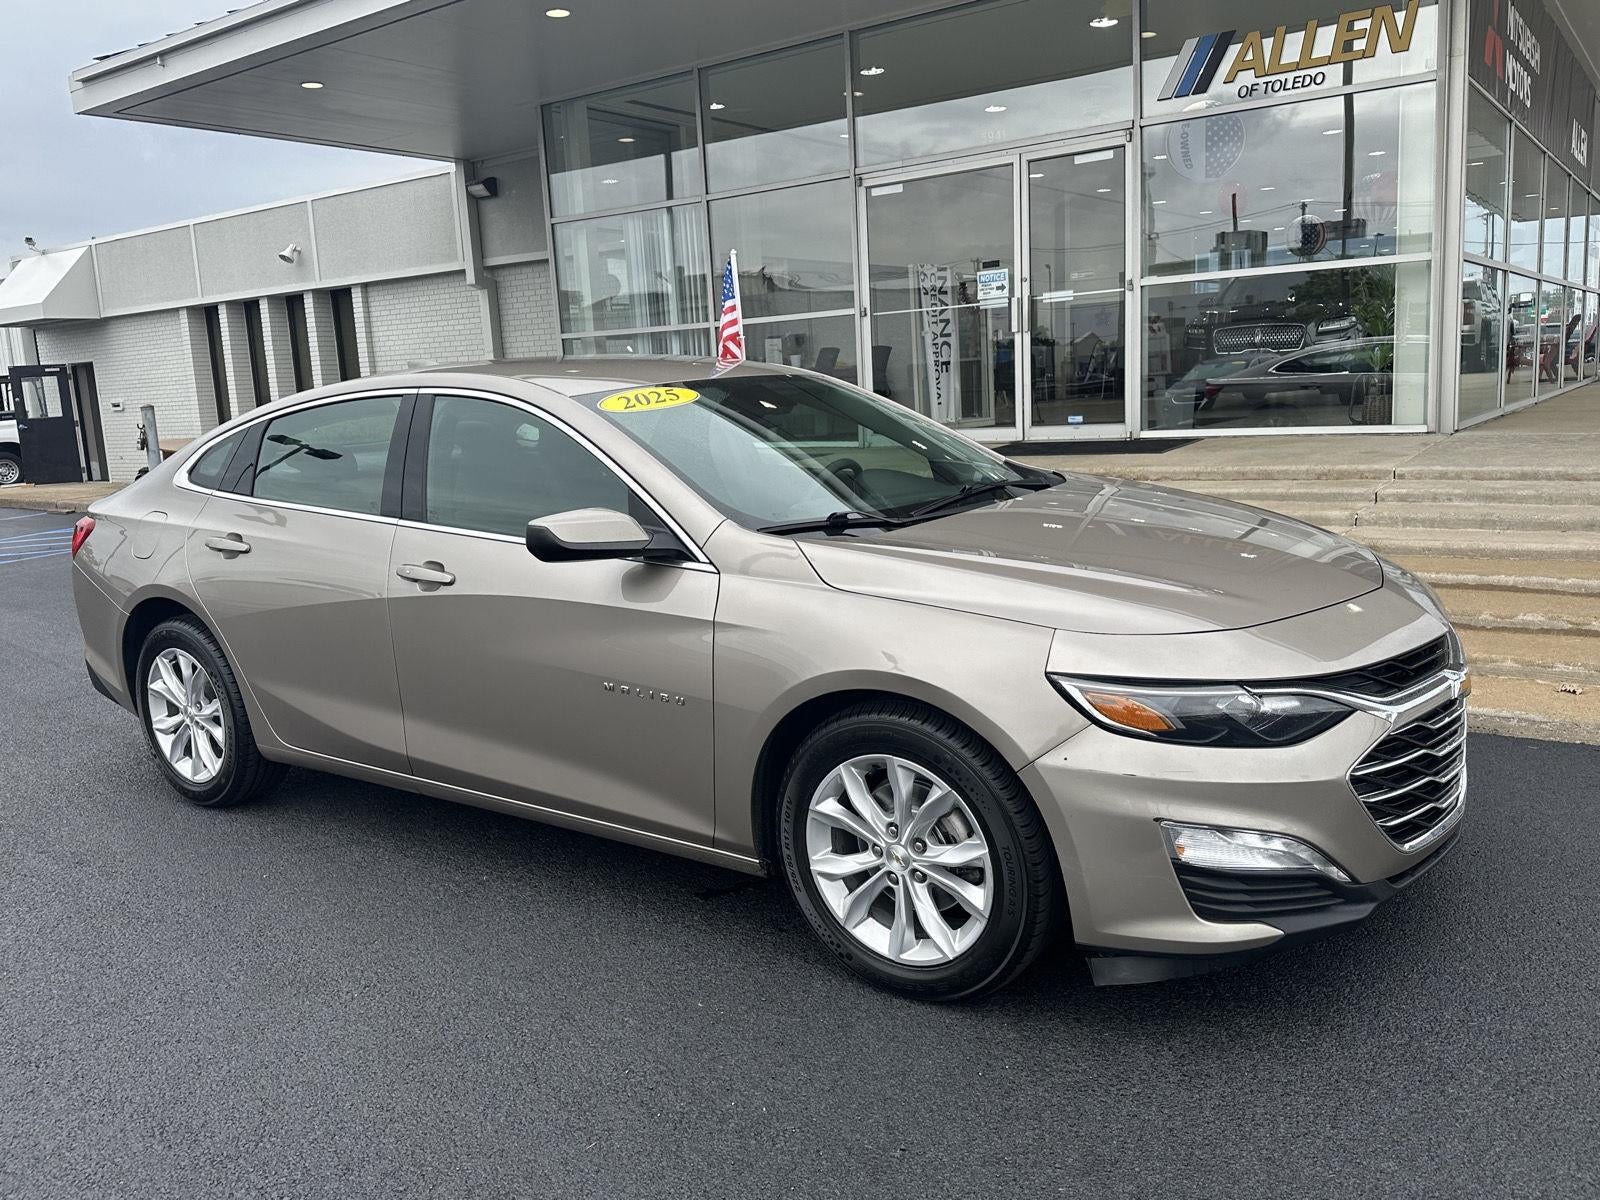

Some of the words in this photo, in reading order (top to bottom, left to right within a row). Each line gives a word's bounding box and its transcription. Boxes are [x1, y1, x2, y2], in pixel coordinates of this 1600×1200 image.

[1223, 0, 1420, 84] ALLEN
[1237, 81, 1258, 99] OF
[1262, 71, 1326, 96] TOLEDO
[1505, 49, 1531, 108] MOTORS
[980, 272, 1005, 283] NOTICE
[929, 272, 939, 327] CREDIT
[617, 388, 680, 410] 2025
[603, 681, 686, 706] MALIBU
[1001, 844, 1017, 898] TOURING
